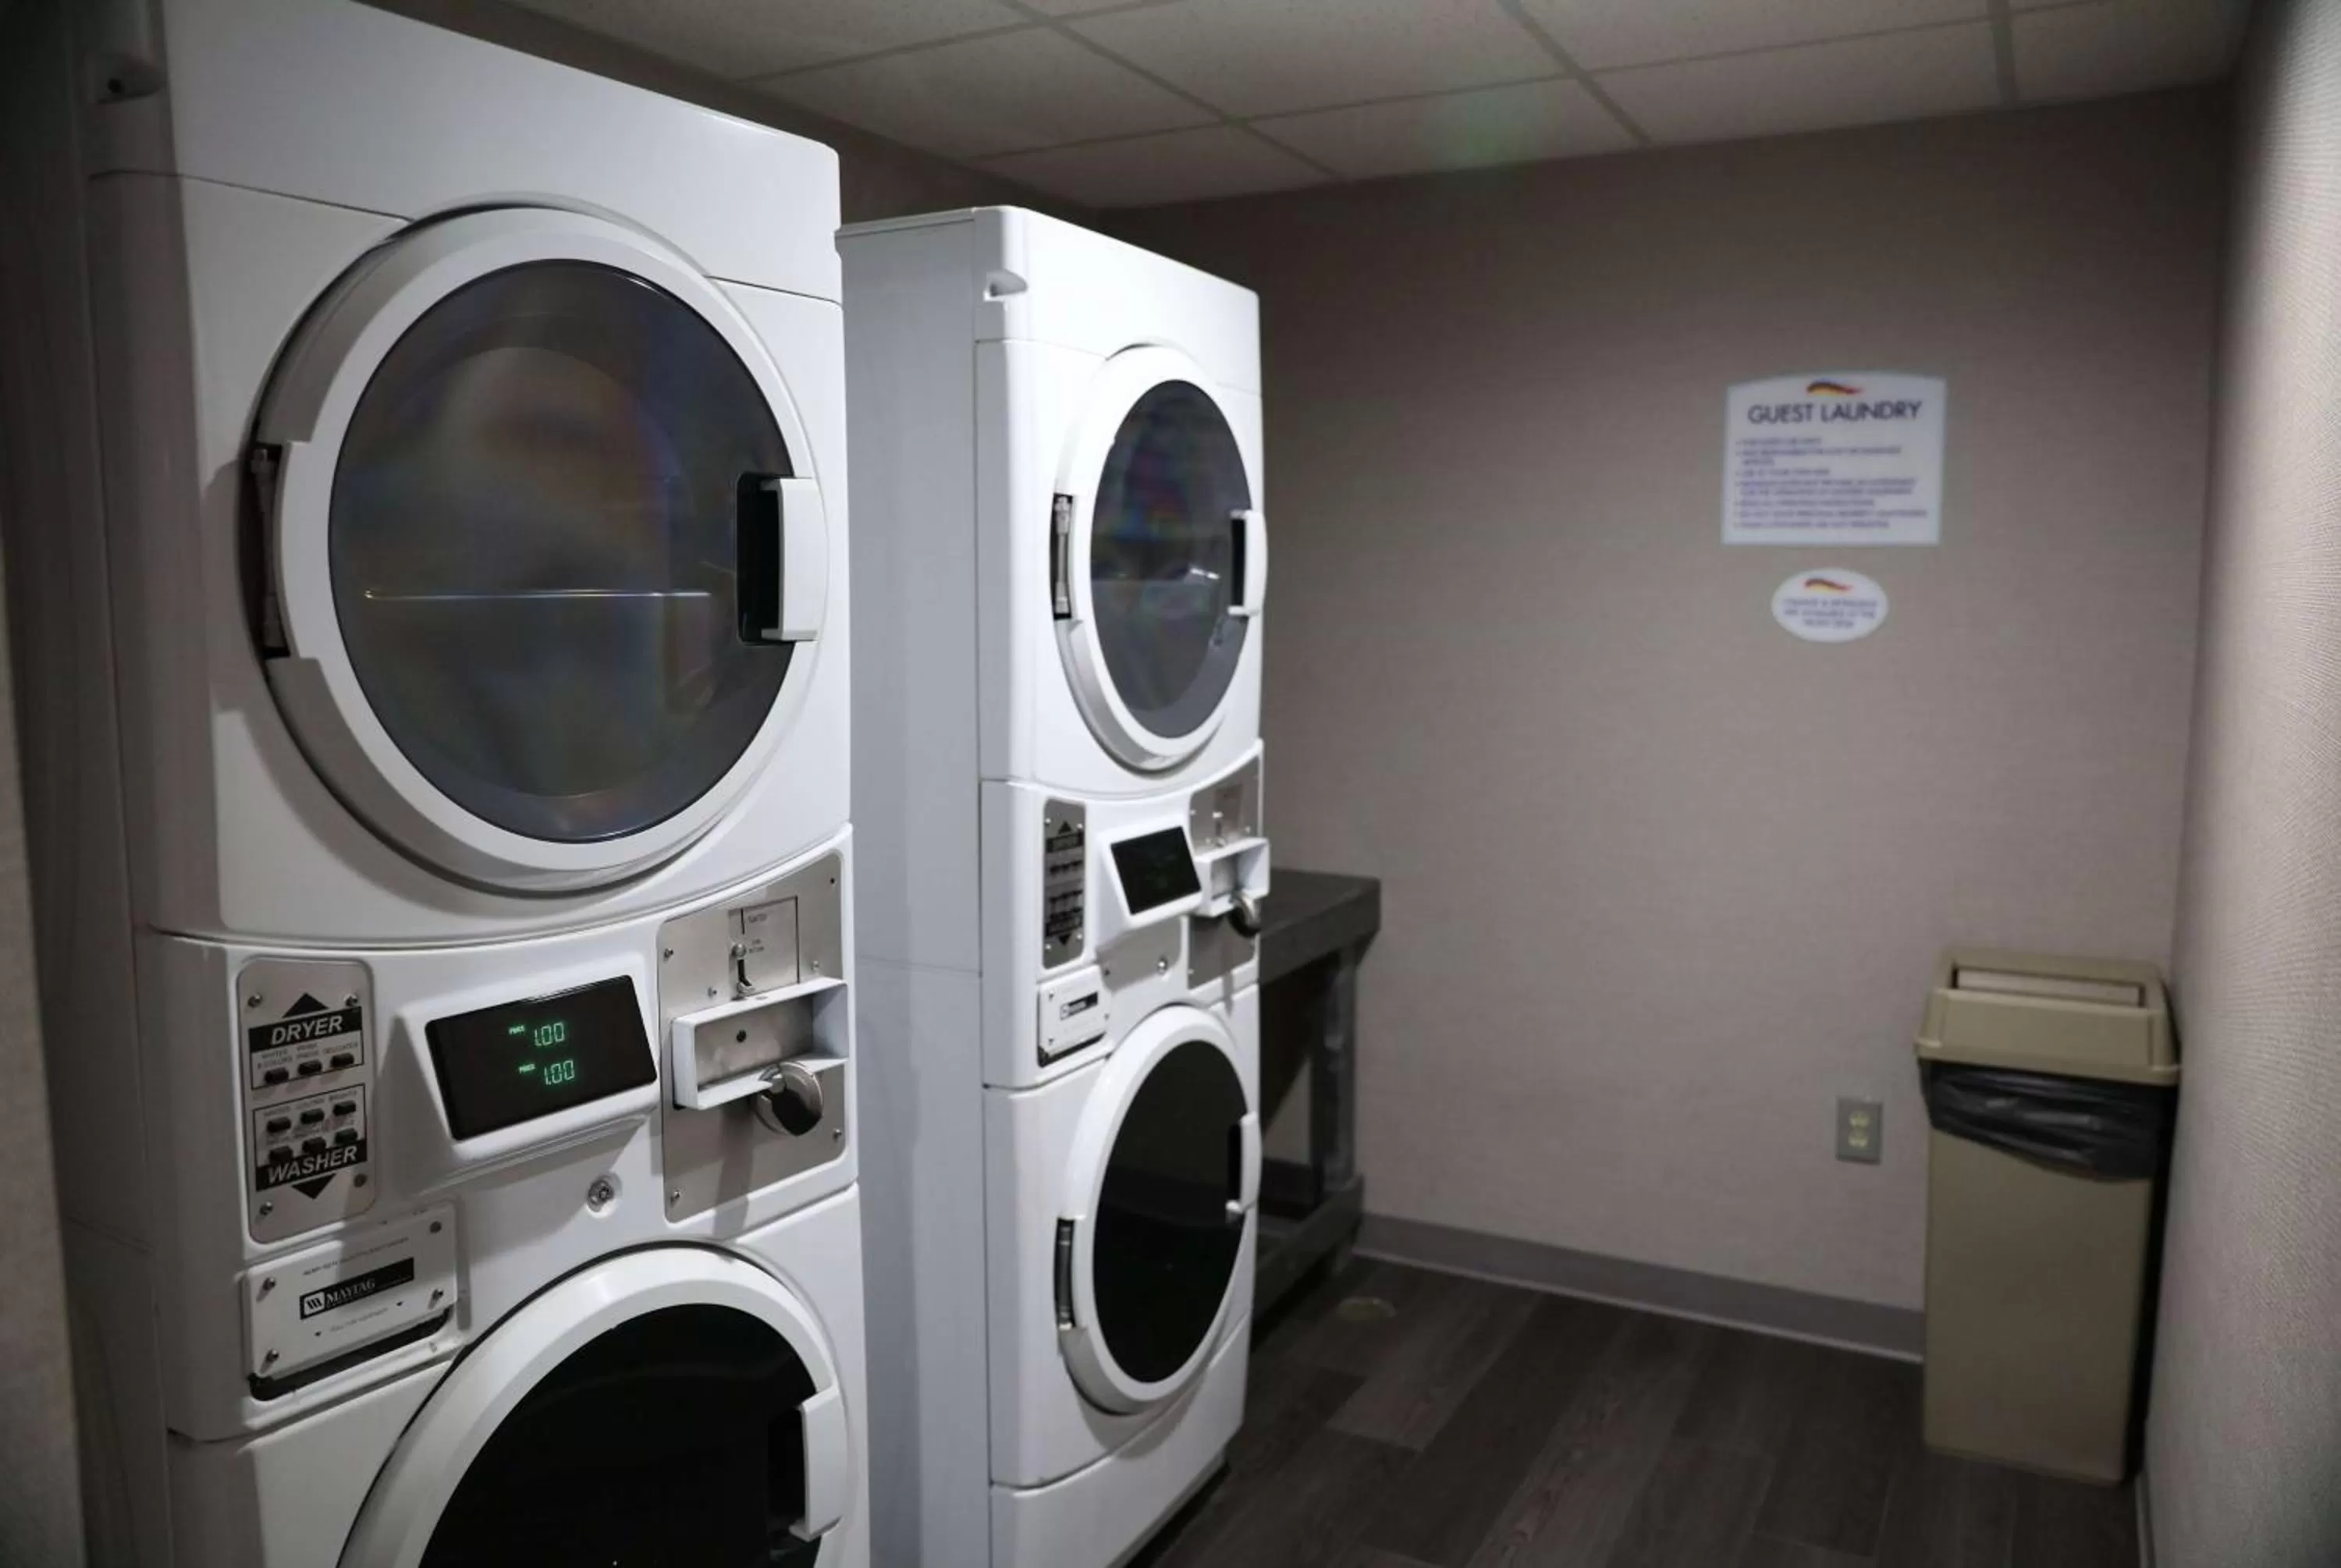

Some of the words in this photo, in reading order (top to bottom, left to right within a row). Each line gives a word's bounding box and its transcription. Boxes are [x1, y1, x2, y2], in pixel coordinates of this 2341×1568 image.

[1747, 404, 1814, 424] GUEST
[1821, 400, 1923, 422] LAUNDRY
[272, 1015, 343, 1045] DRYER
[268, 1144, 357, 1183] WASHER
[325, 1278, 375, 1303] MAYTAG
